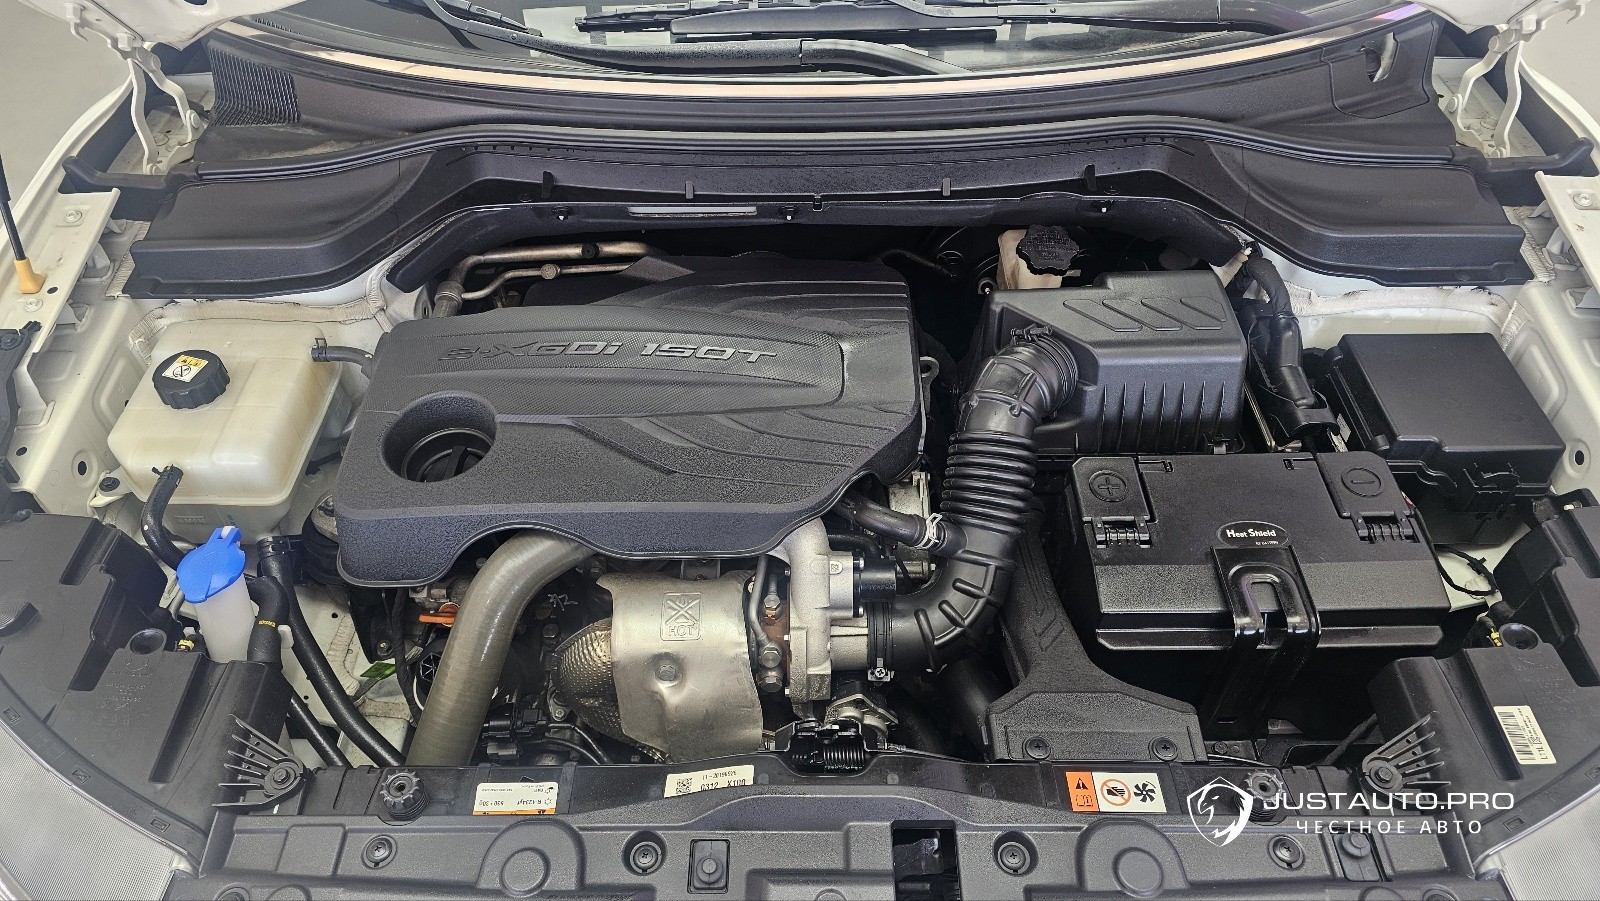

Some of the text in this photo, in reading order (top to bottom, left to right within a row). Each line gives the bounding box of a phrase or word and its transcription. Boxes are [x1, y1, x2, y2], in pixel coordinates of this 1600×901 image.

[640, 342, 777, 363] 150T
[1226, 528, 1277, 538] Heat Shield
[668, 624, 694, 637] HOT
